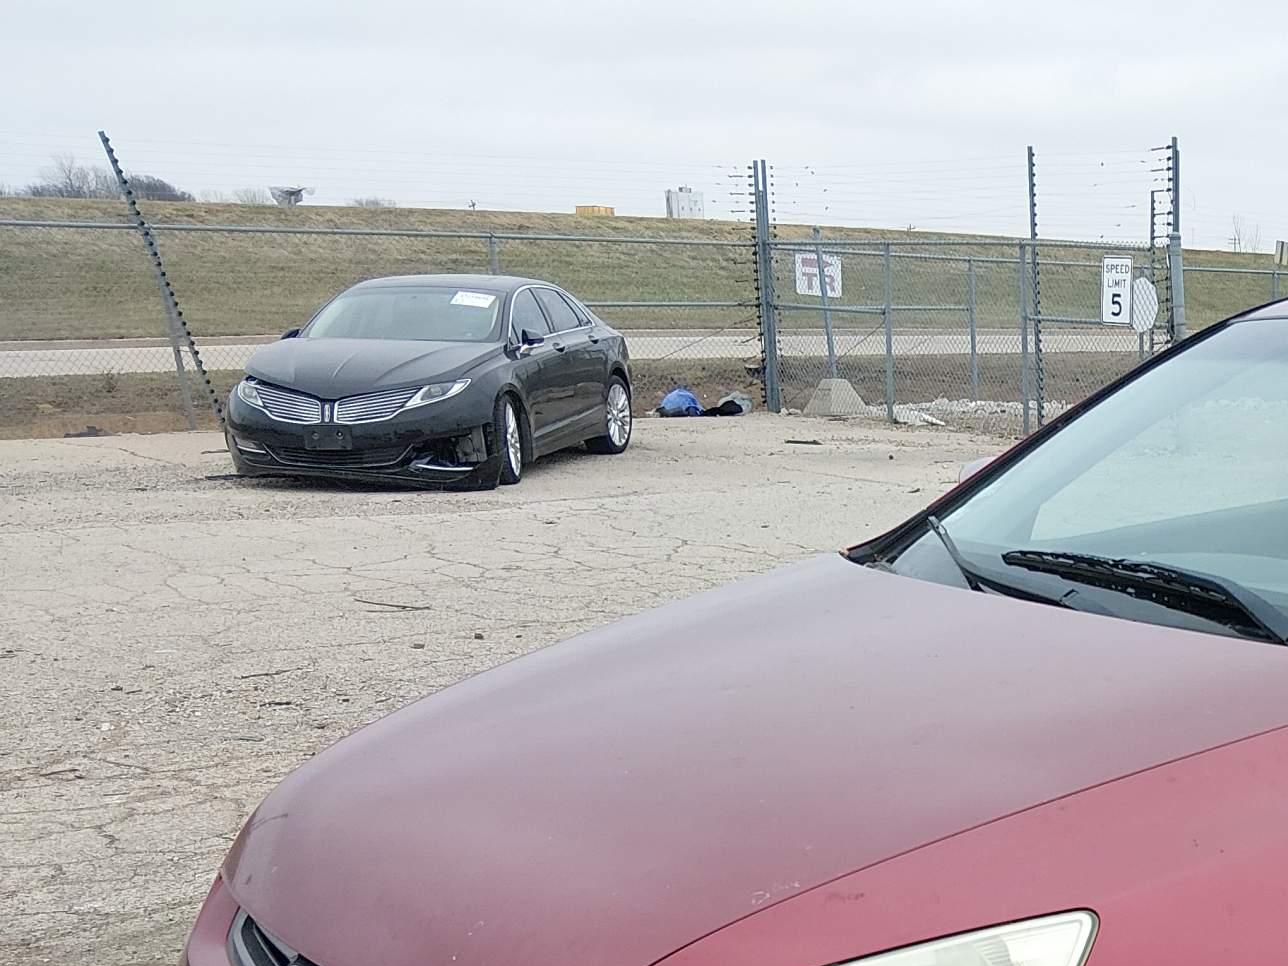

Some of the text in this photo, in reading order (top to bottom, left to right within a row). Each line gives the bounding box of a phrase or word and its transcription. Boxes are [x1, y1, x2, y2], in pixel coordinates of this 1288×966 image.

[1105, 263, 1130, 274] SPEED
[1107, 279, 1127, 289] LIMIT
[1111, 292, 1123, 317] 5
